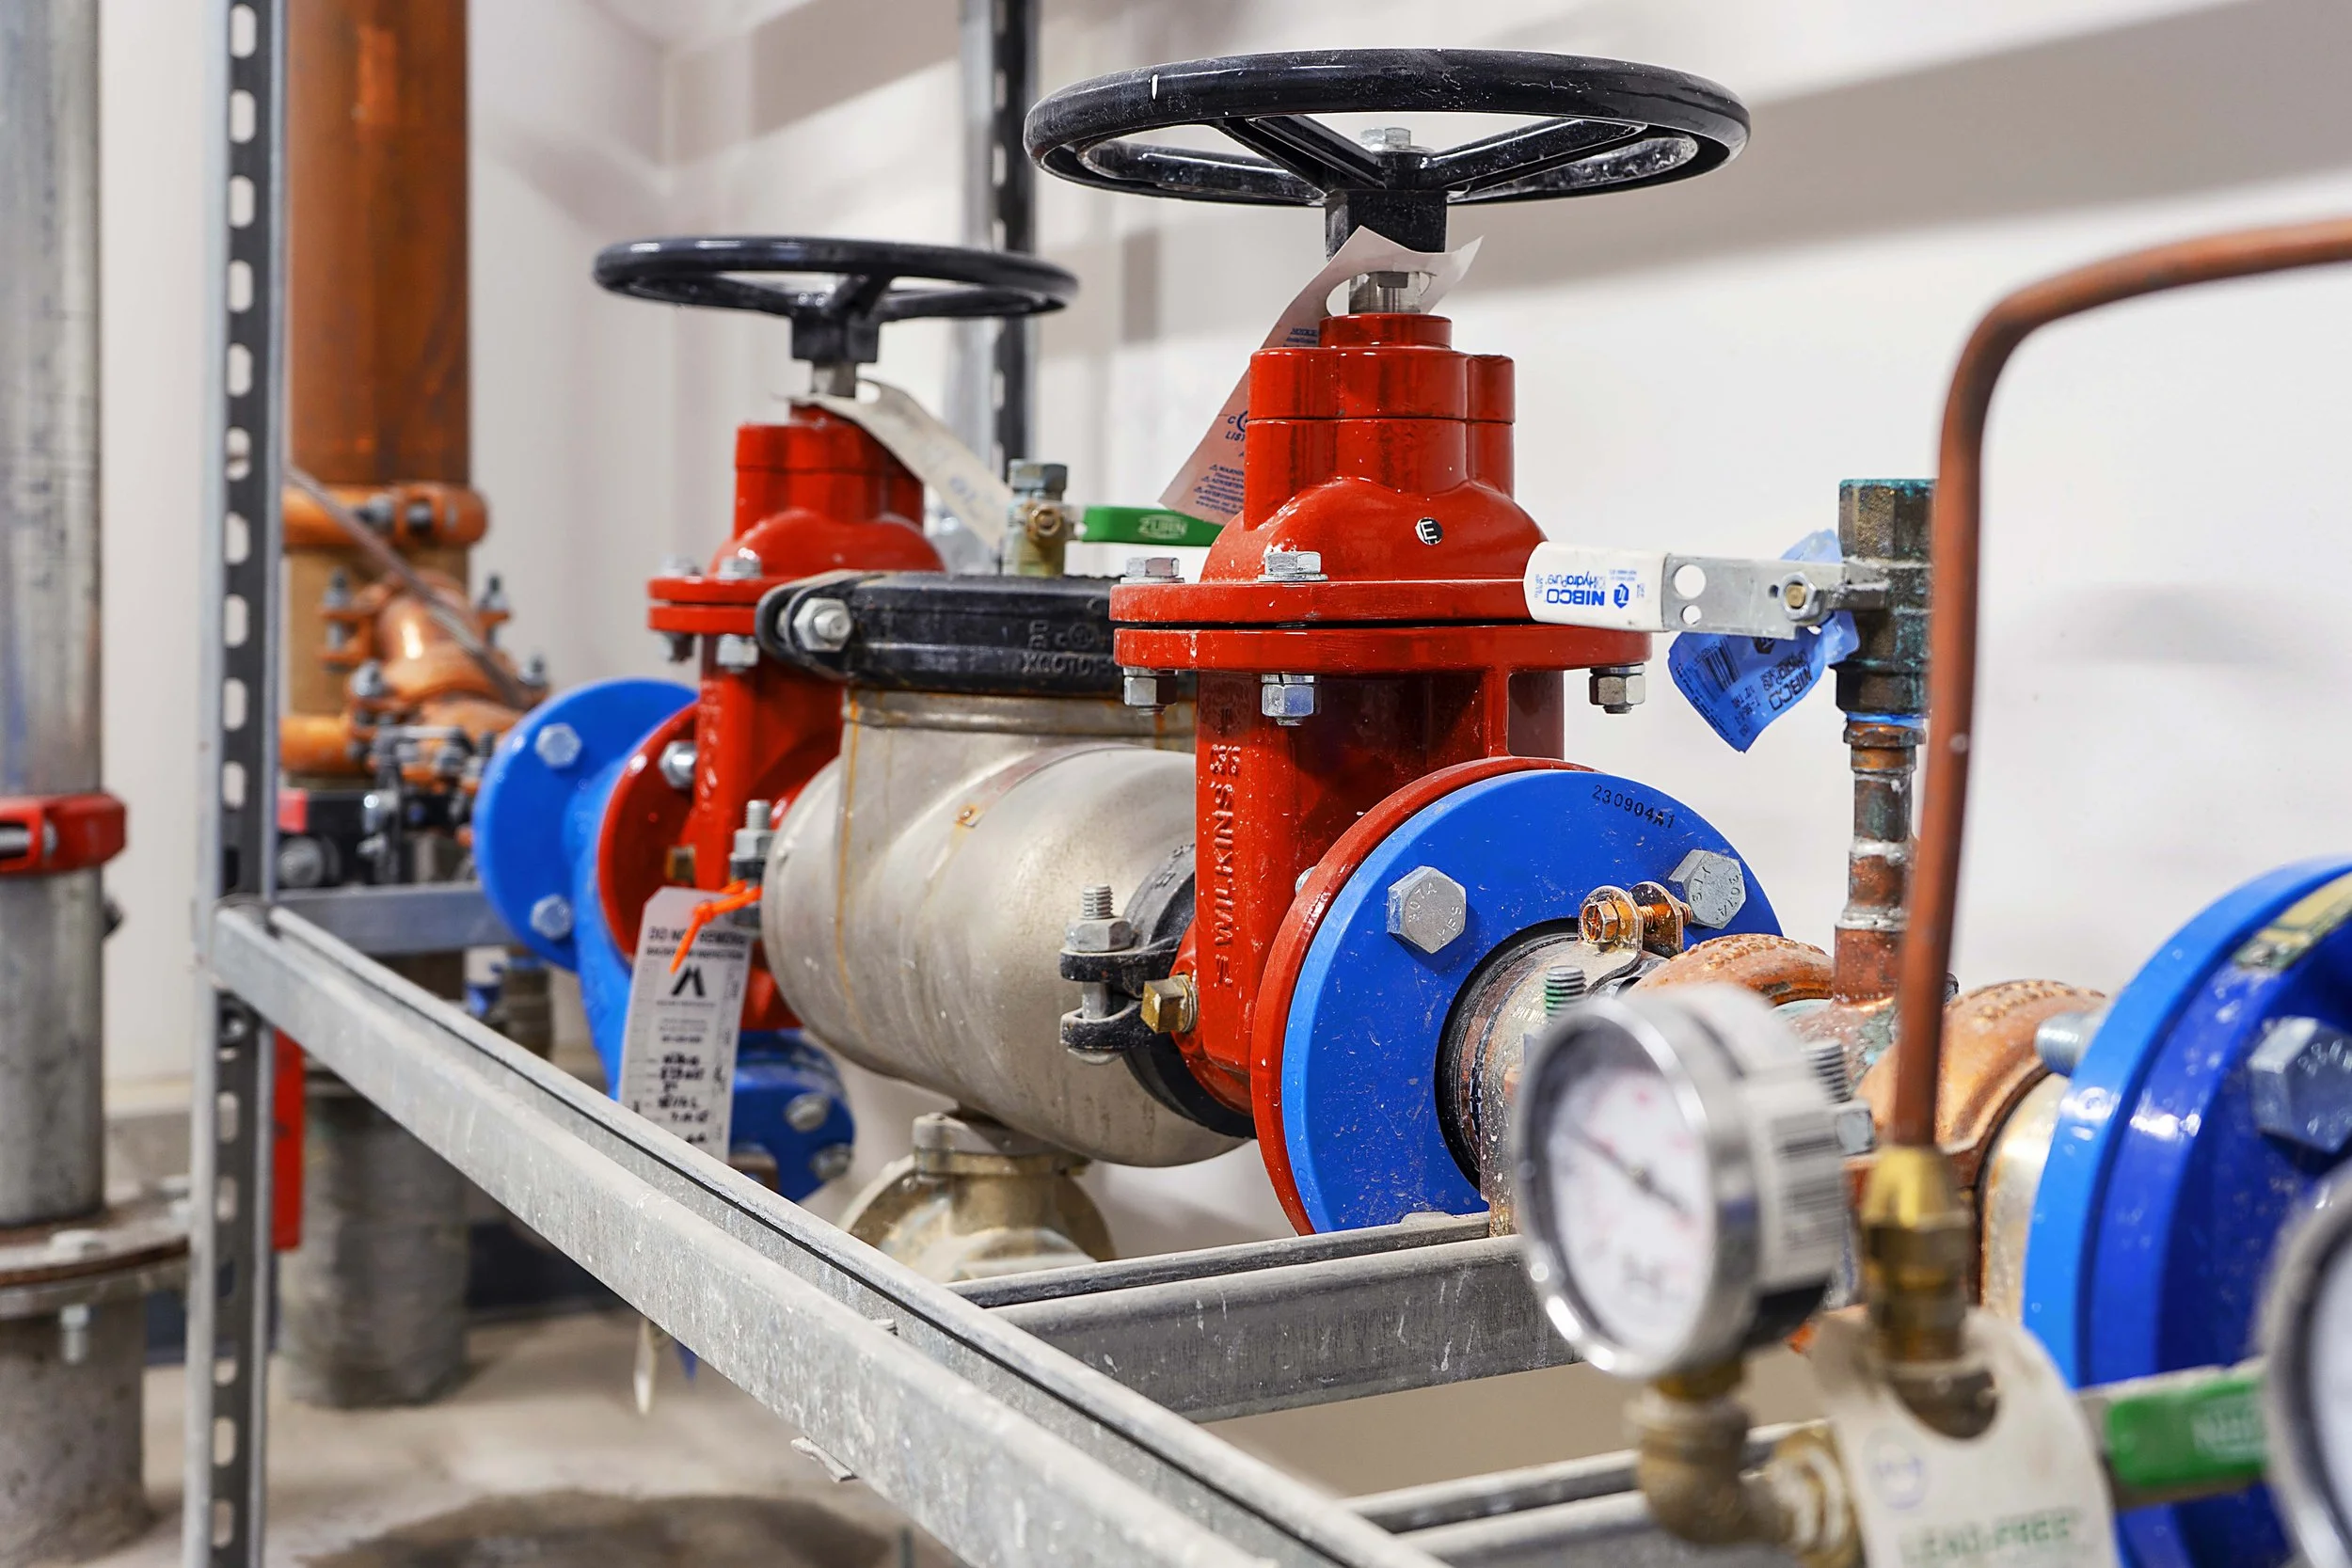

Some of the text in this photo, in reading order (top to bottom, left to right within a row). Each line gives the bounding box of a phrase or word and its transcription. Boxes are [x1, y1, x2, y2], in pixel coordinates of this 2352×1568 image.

[1547, 570, 1597, 589] HydraPure
[1545, 588, 1605, 606] NIBCO
[1591, 784, 1676, 829] 230904A1
